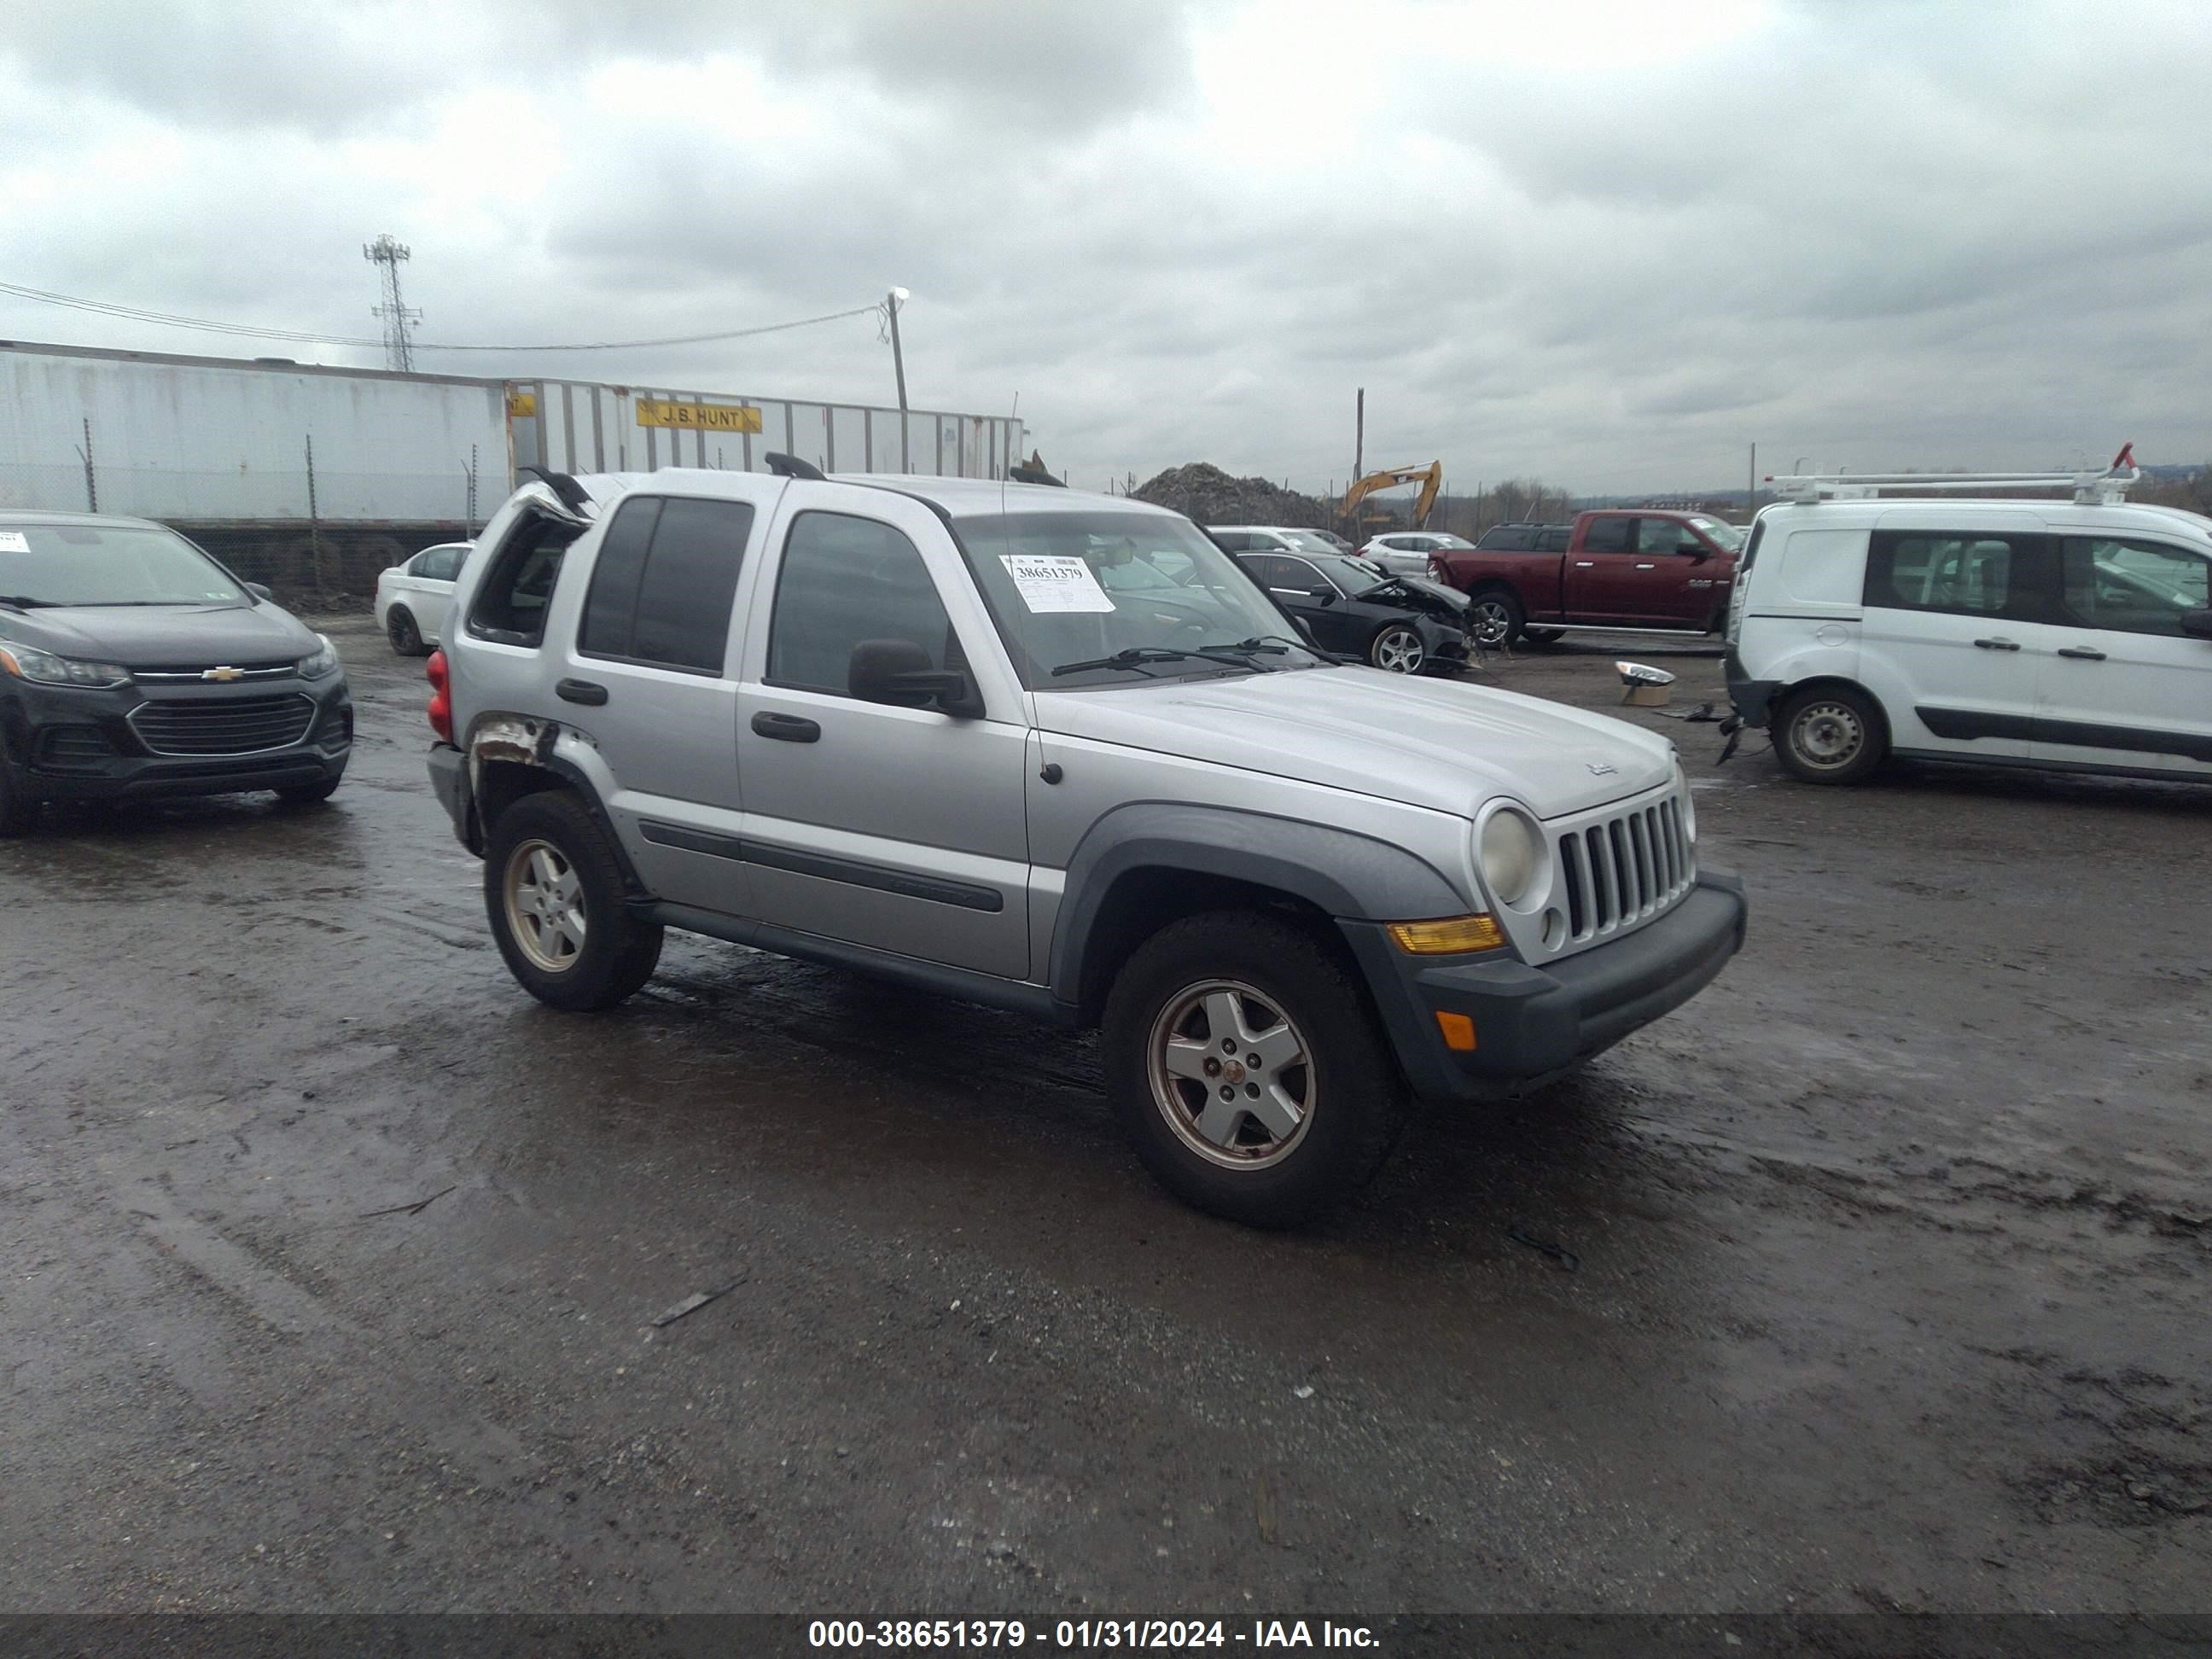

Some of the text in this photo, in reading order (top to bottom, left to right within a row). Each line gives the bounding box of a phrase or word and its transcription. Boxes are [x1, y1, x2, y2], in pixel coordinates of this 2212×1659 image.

[663, 406, 739, 426] J.B. HUNT
[1016, 567, 1083, 579] 38651379
